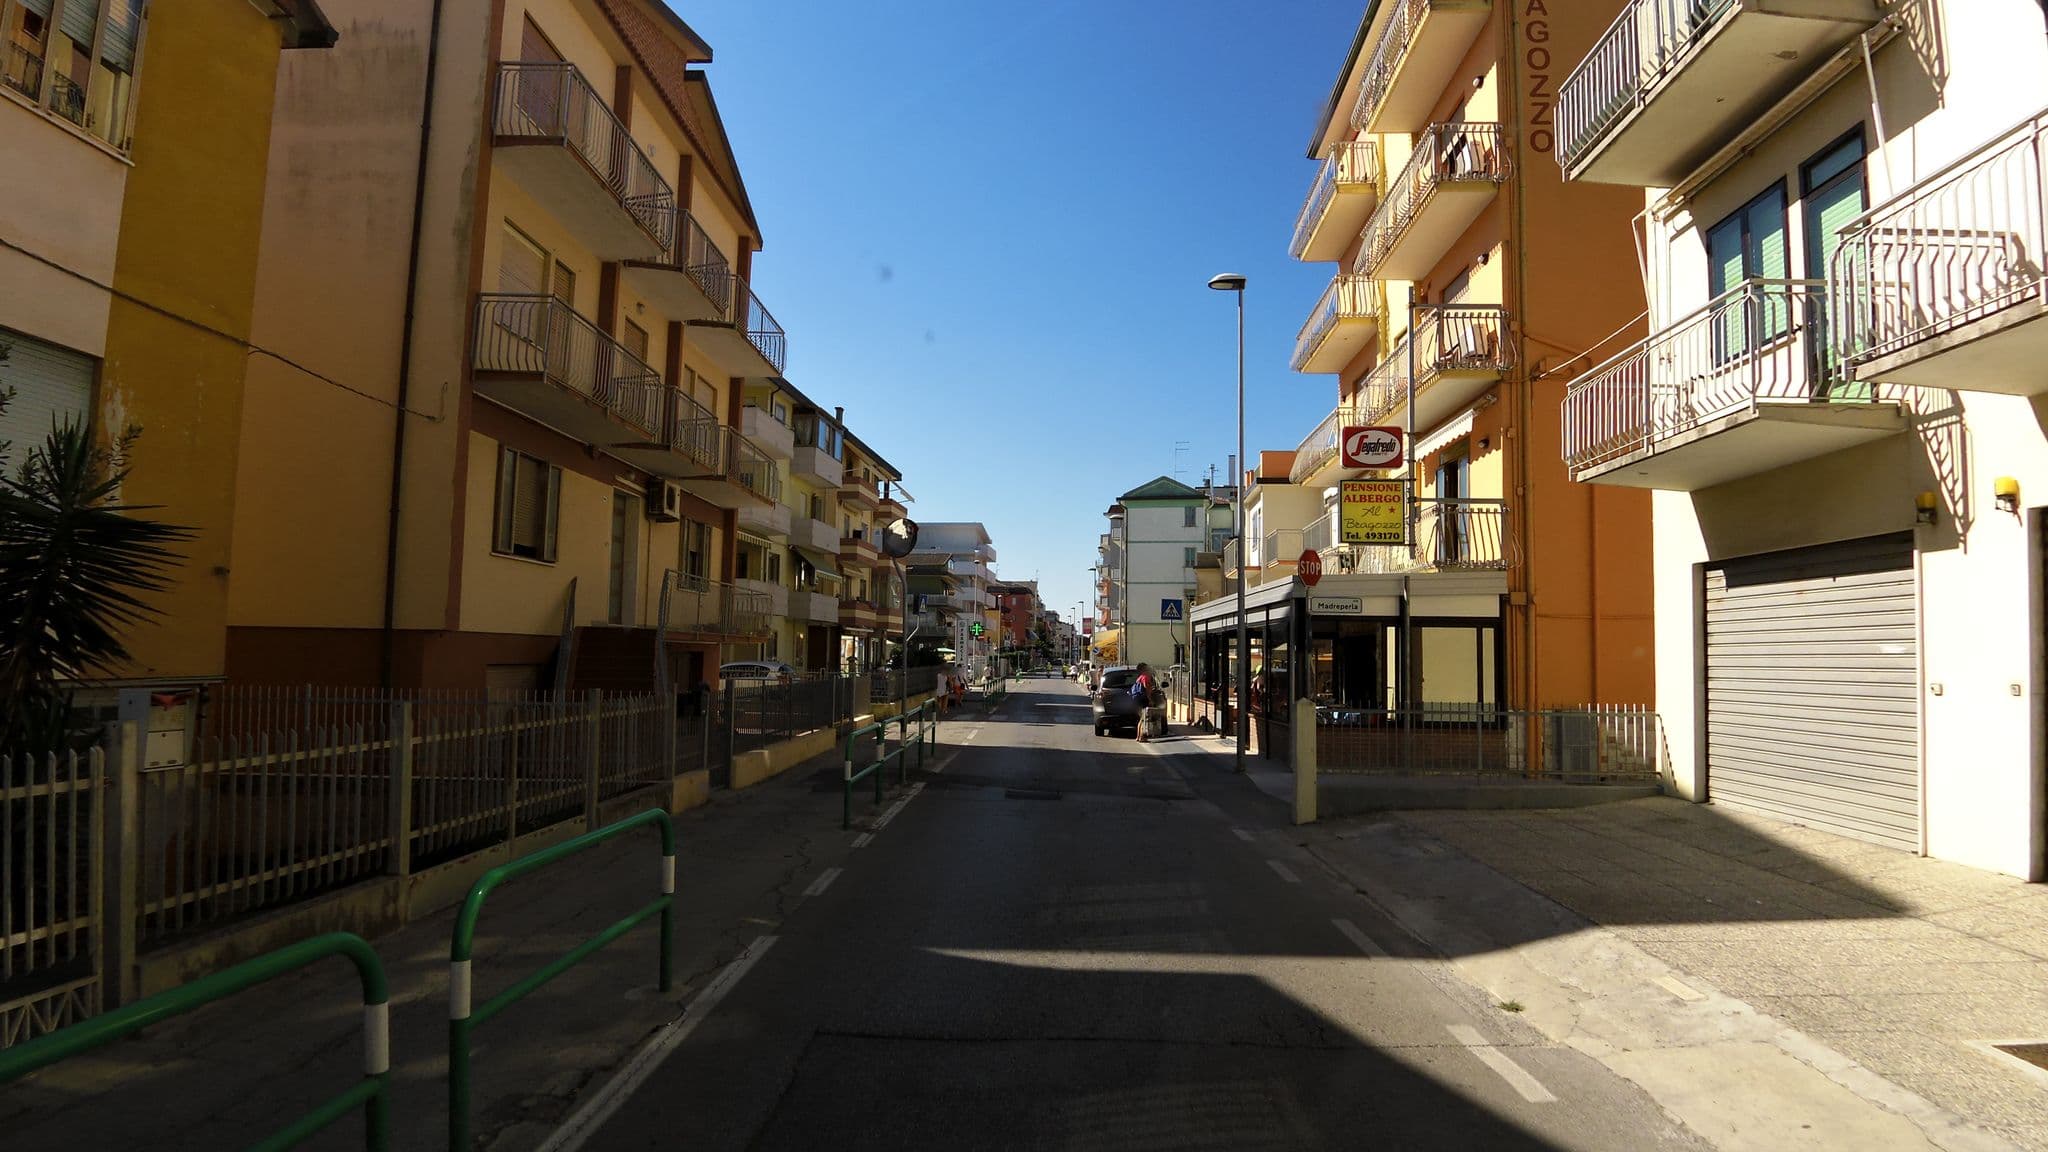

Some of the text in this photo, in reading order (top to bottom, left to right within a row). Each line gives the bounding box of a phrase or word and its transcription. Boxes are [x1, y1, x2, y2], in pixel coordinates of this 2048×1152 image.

[1351, 435, 1396, 456] Segafredo
[1344, 483, 1401, 492] PENSIONE
[1344, 494, 1401, 503] ALBERGO
[1361, 505, 1381, 517] Al
[1344, 518, 1401, 531] Bragozzo
[1345, 531, 1400, 540] Tel. 493170
[1300, 560, 1320, 576] STOP
[1318, 602, 1358, 611] Madreperla
